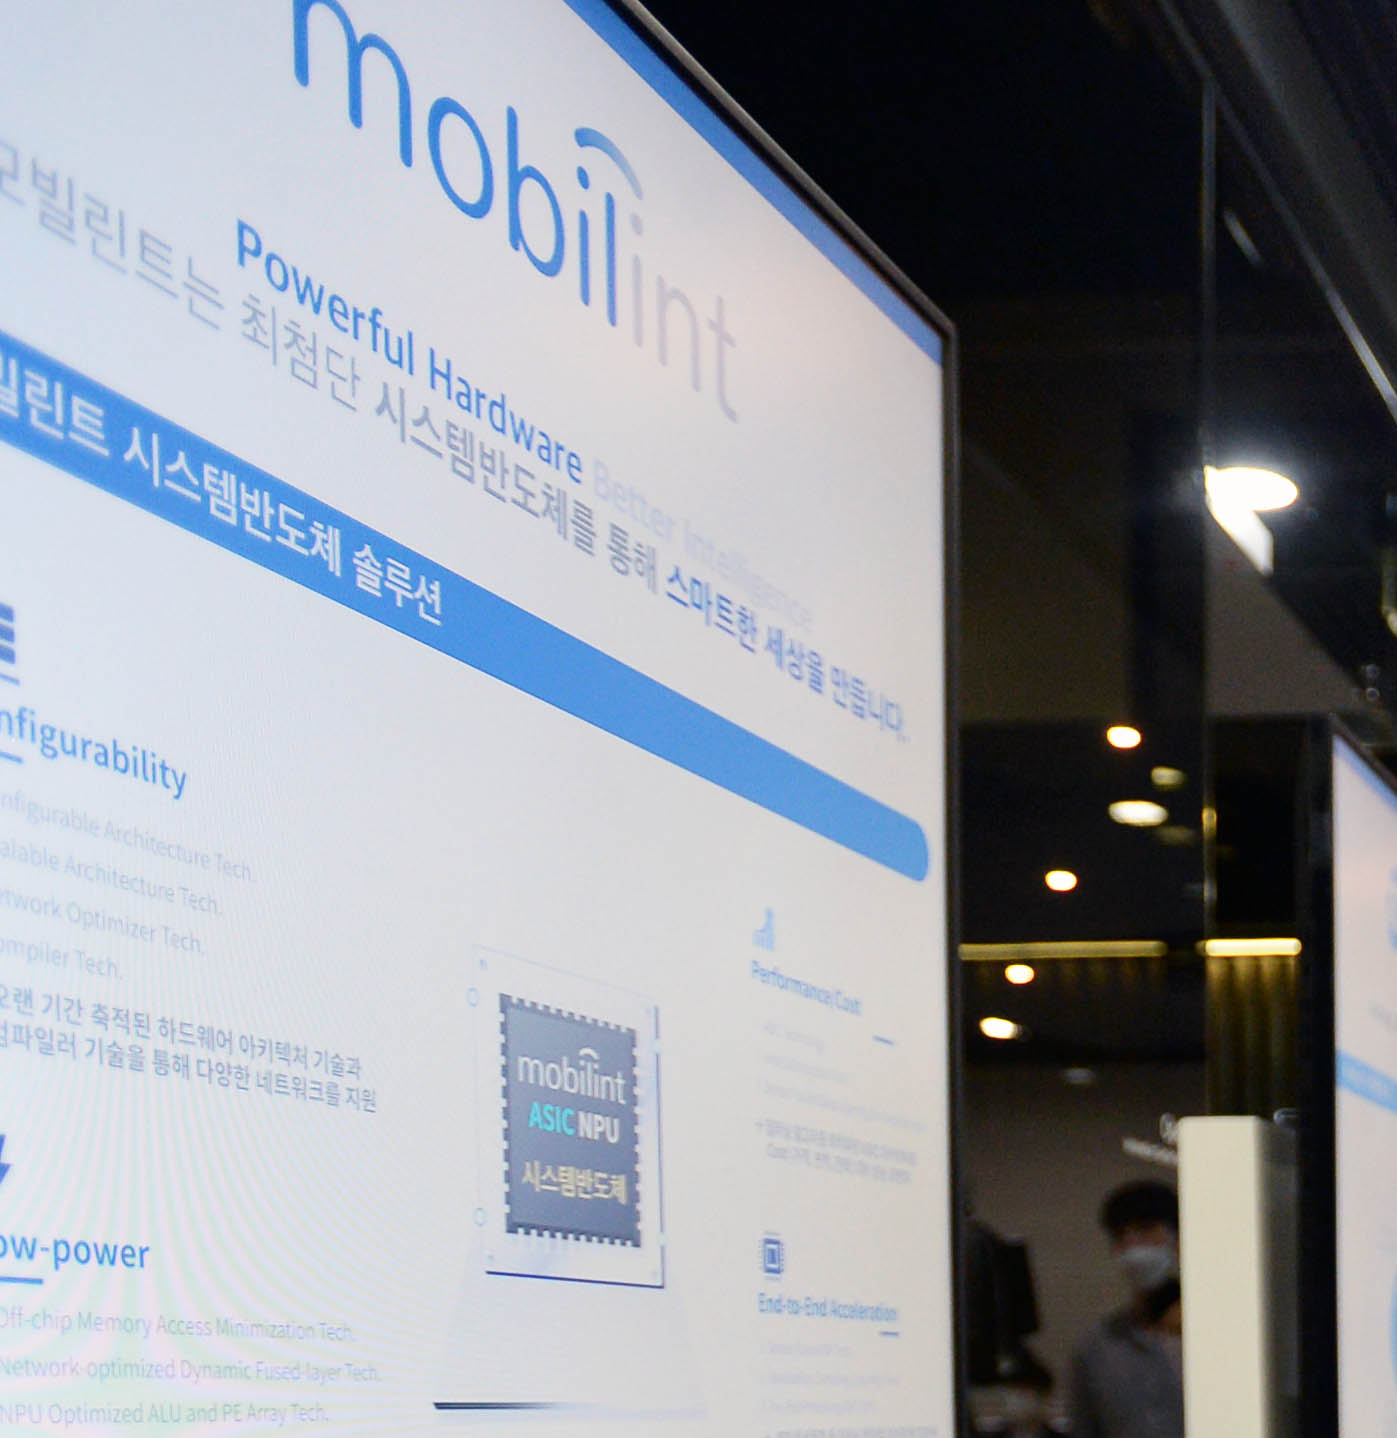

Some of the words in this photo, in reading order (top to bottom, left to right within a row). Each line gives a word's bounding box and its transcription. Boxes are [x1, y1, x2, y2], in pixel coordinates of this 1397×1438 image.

[292, 0, 739, 422] mobilint
[236, 217, 414, 376] Powerful
[429, 347, 583, 484] Hardware
[593, 457, 677, 542] Better
[241, 293, 360, 412] 최첨단
[375, 381, 597, 556] 시스템반도체를
[606, 522, 658, 594] 통해
[666, 564, 758, 654] 스마트한
[764, 625, 824, 695] 세상을
[123, 425, 342, 578] 시스템반도체
[351, 541, 444, 627] 솔루션
[104, 820, 210, 866] Architecture
[64, 854, 175, 902] Architecture
[66, 901, 155, 942] Optimizer
[42, 992, 84, 1027] 기간
[157, 1016, 235, 1056] 하드웨어
[85, 1036, 145, 1073] 기술을
[152, 1049, 190, 1079] 통해
[196, 1058, 250, 1092] 다양한
[517, 1047, 627, 1105] mobilint
[528, 1101, 575, 1136] ASIC
[577, 1110, 621, 1144] NPU
[521, 1158, 629, 1206] 시스템반도체
[77, 1310, 152, 1339] Memory
[155, 1314, 212, 1337] Access
[180, 1358, 252, 1385] Dynamic
[48, 1402, 144, 1428] Optimized
[186, 1402, 217, 1423] and
[246, 1402, 286, 1427] Array
